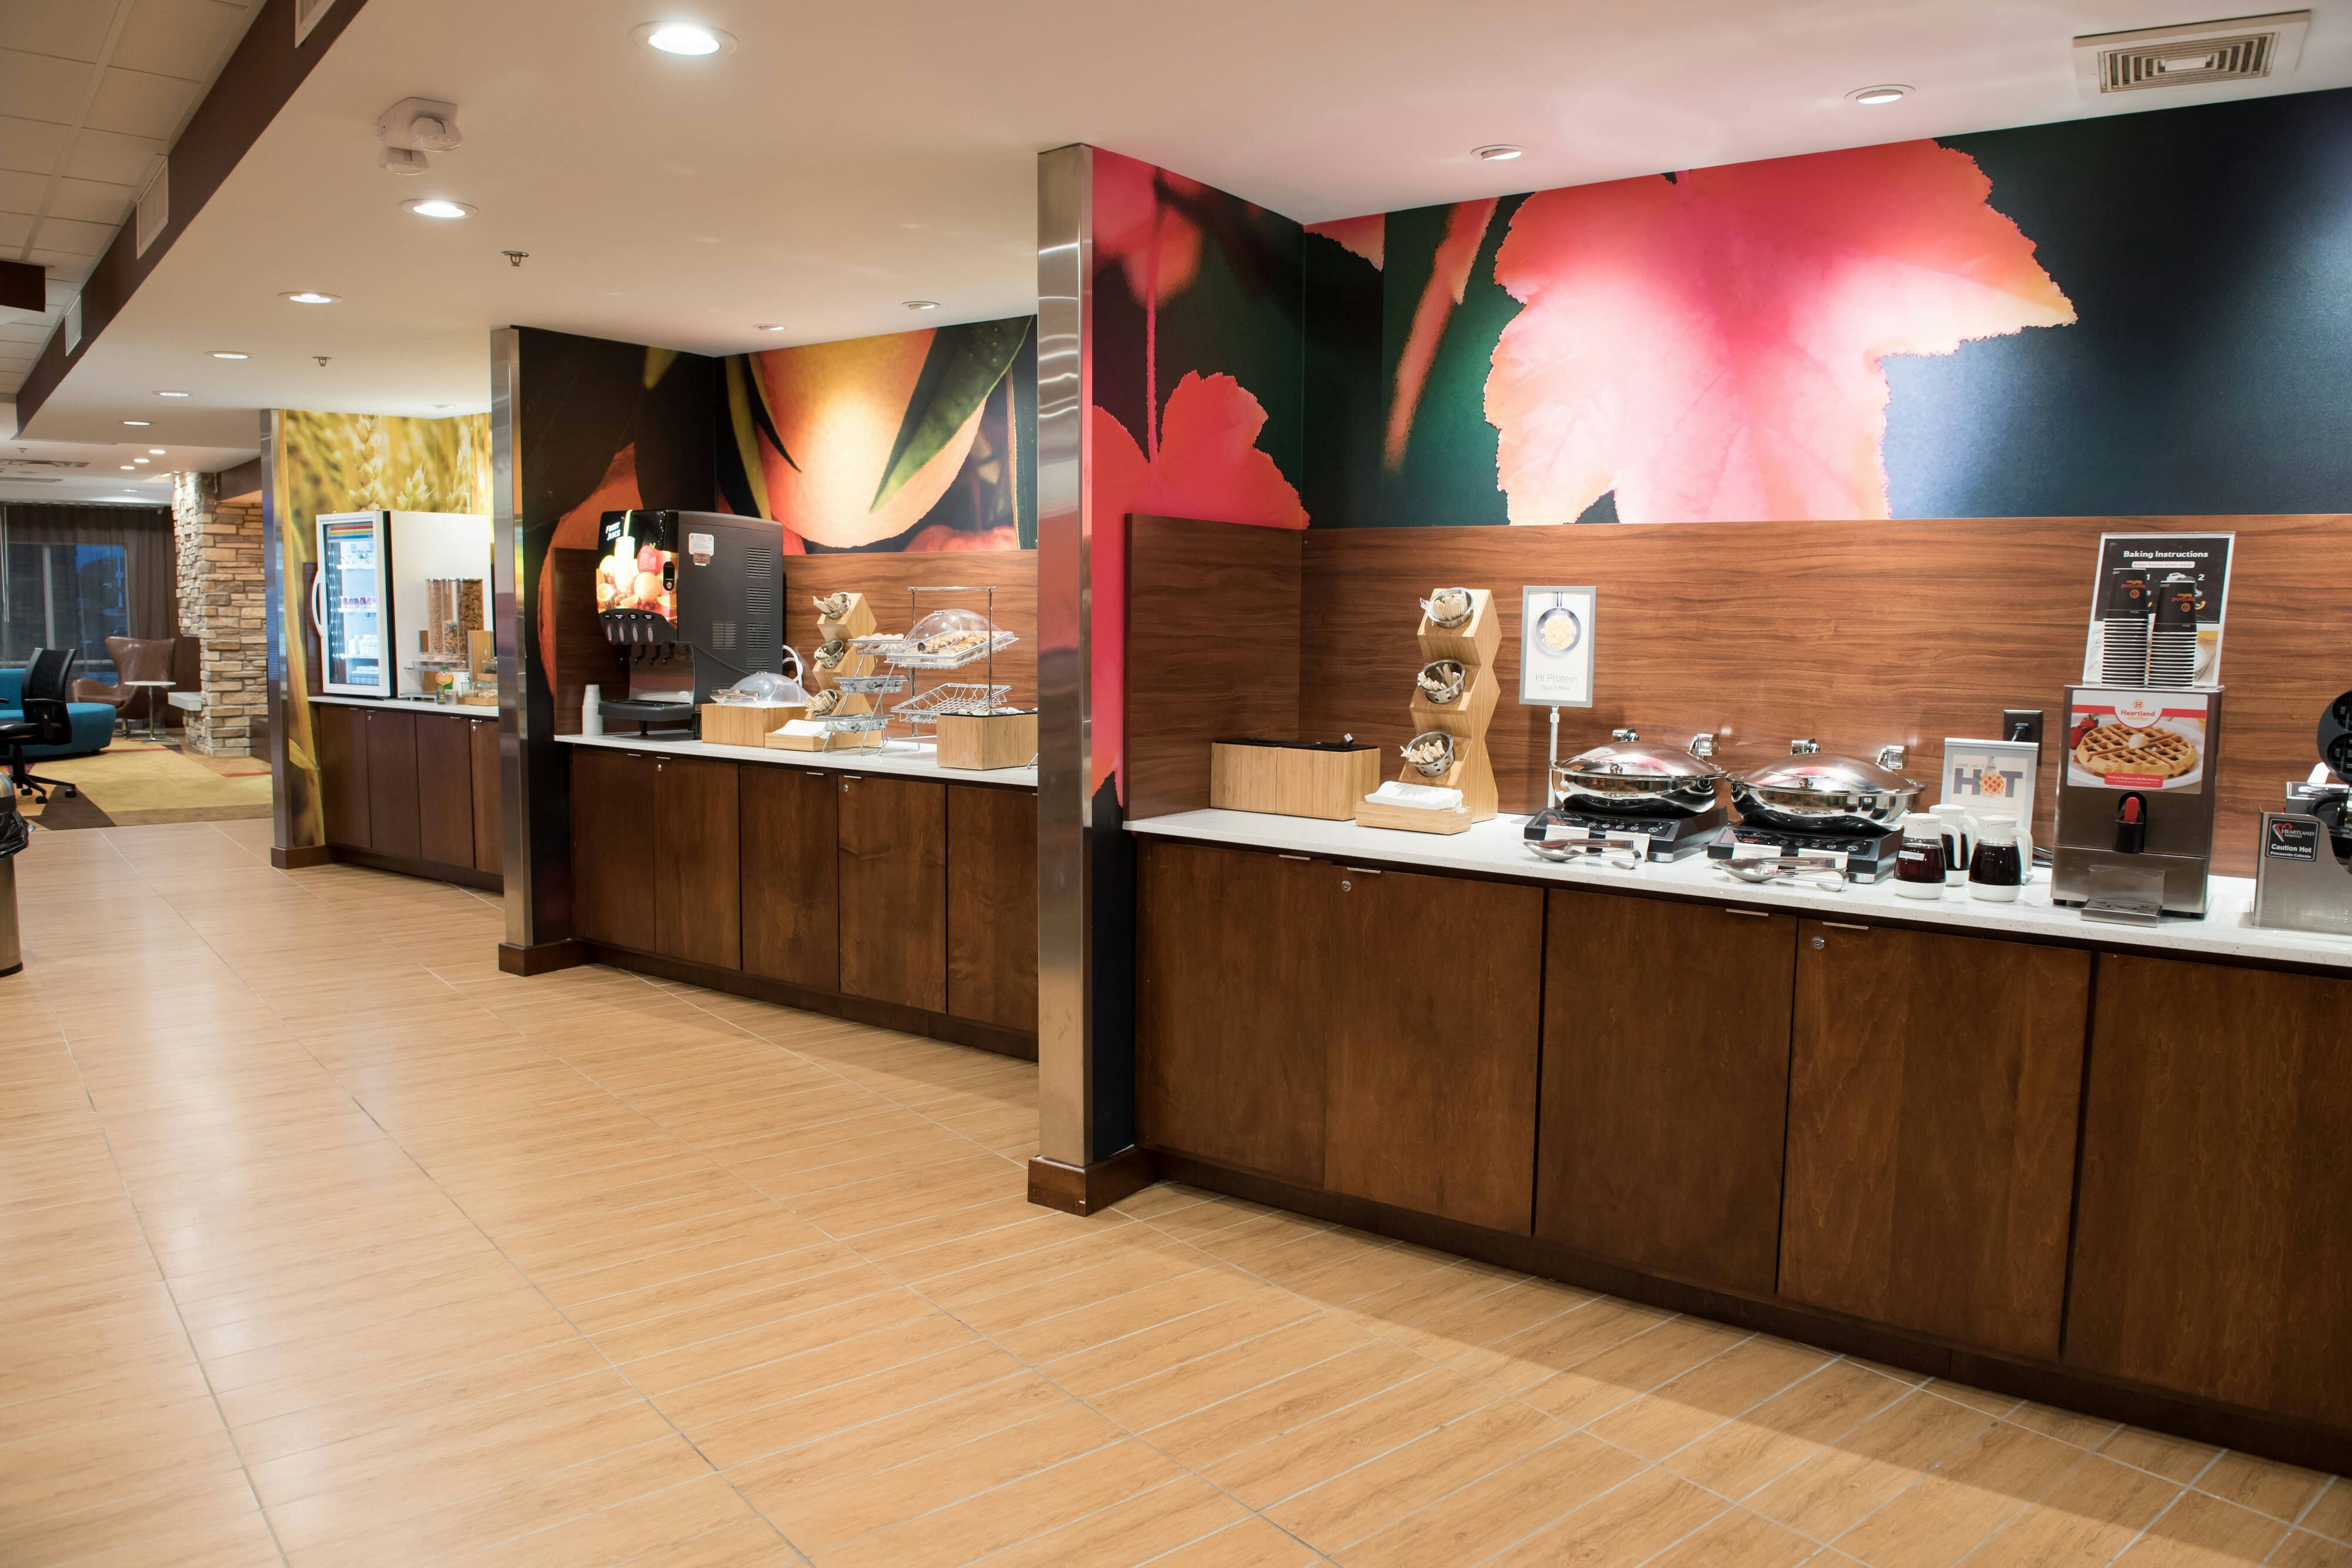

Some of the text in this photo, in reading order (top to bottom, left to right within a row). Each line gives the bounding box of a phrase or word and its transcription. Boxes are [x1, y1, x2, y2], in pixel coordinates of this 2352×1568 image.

[607, 529, 621, 541] JUICE
[2123, 550, 2154, 559] Baking
[1535, 673, 1577, 683] Hi Protein
[2121, 709, 2155, 717] Heartland
[1953, 768, 2023, 798] HT
